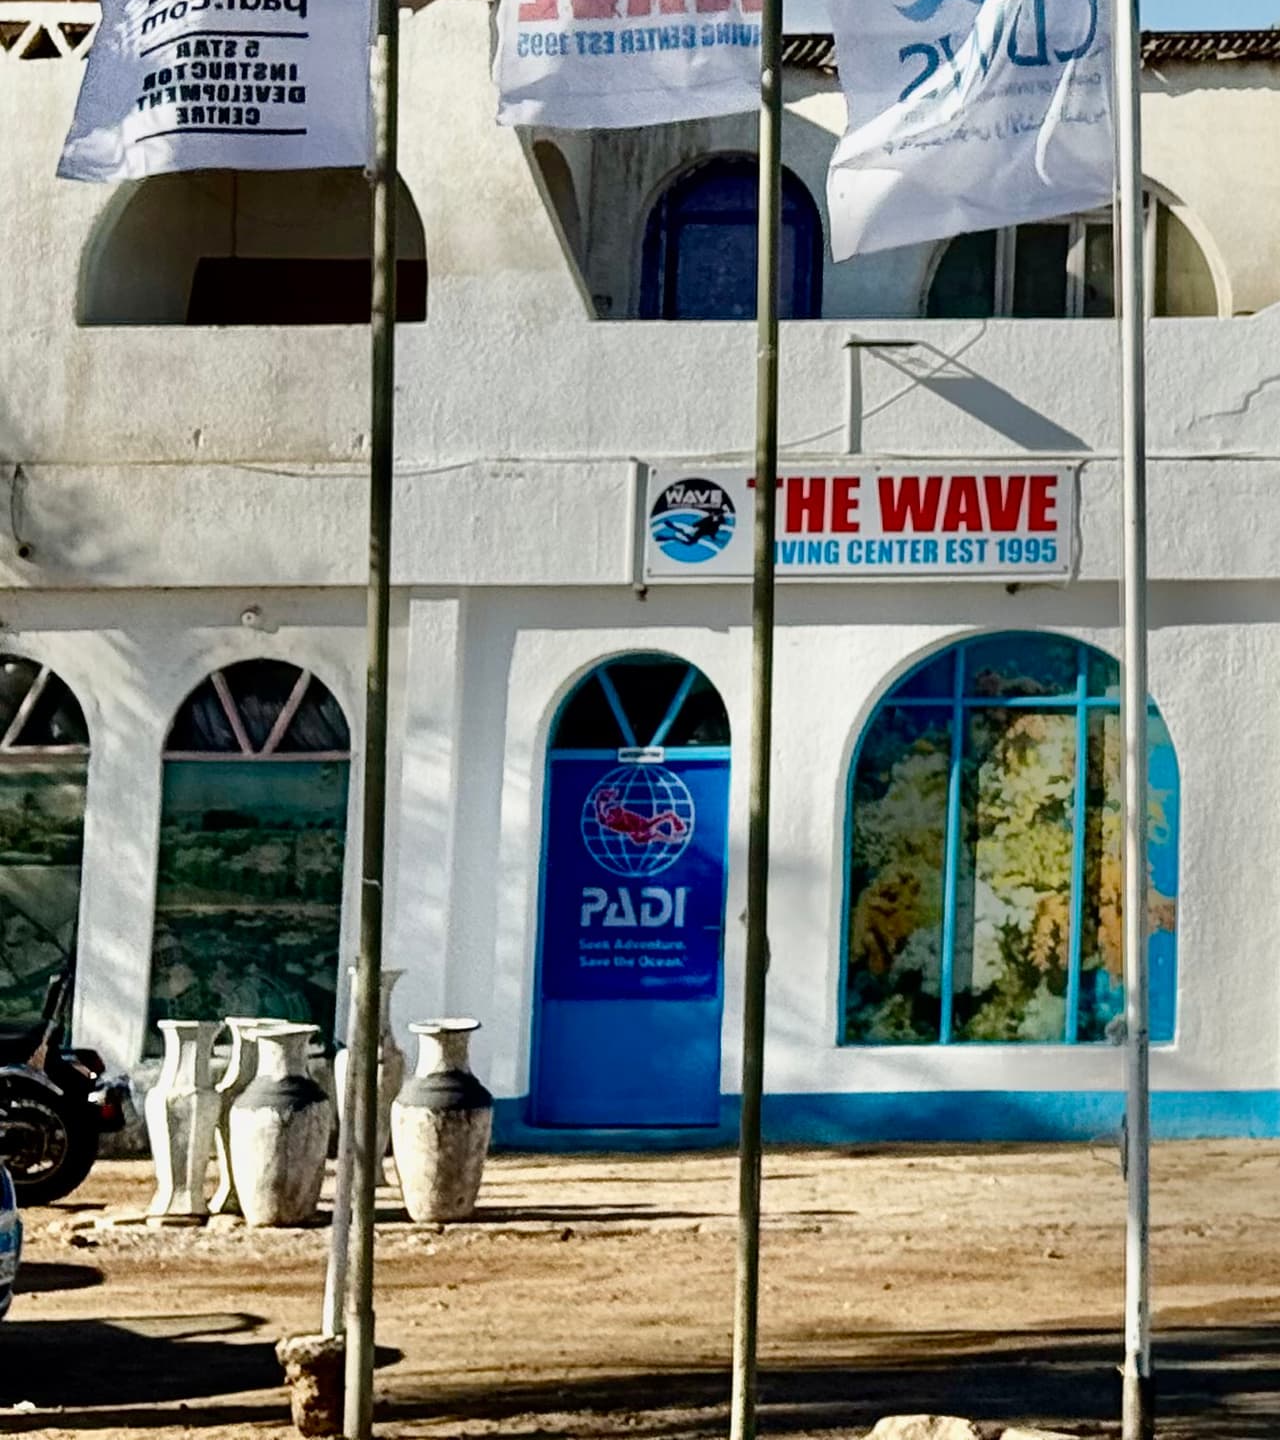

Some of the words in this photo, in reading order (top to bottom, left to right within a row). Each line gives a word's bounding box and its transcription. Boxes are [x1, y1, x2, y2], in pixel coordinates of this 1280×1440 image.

[666, 489, 722, 504] WAVE
[747, 477, 860, 533] HE
[878, 475, 1057, 532] WAVE
[773, 539, 839, 565] IVING
[847, 539, 939, 564] CENTER
[946, 539, 988, 564] EST
[996, 538, 1057, 564] 1995
[580, 887, 686, 928] PADI
